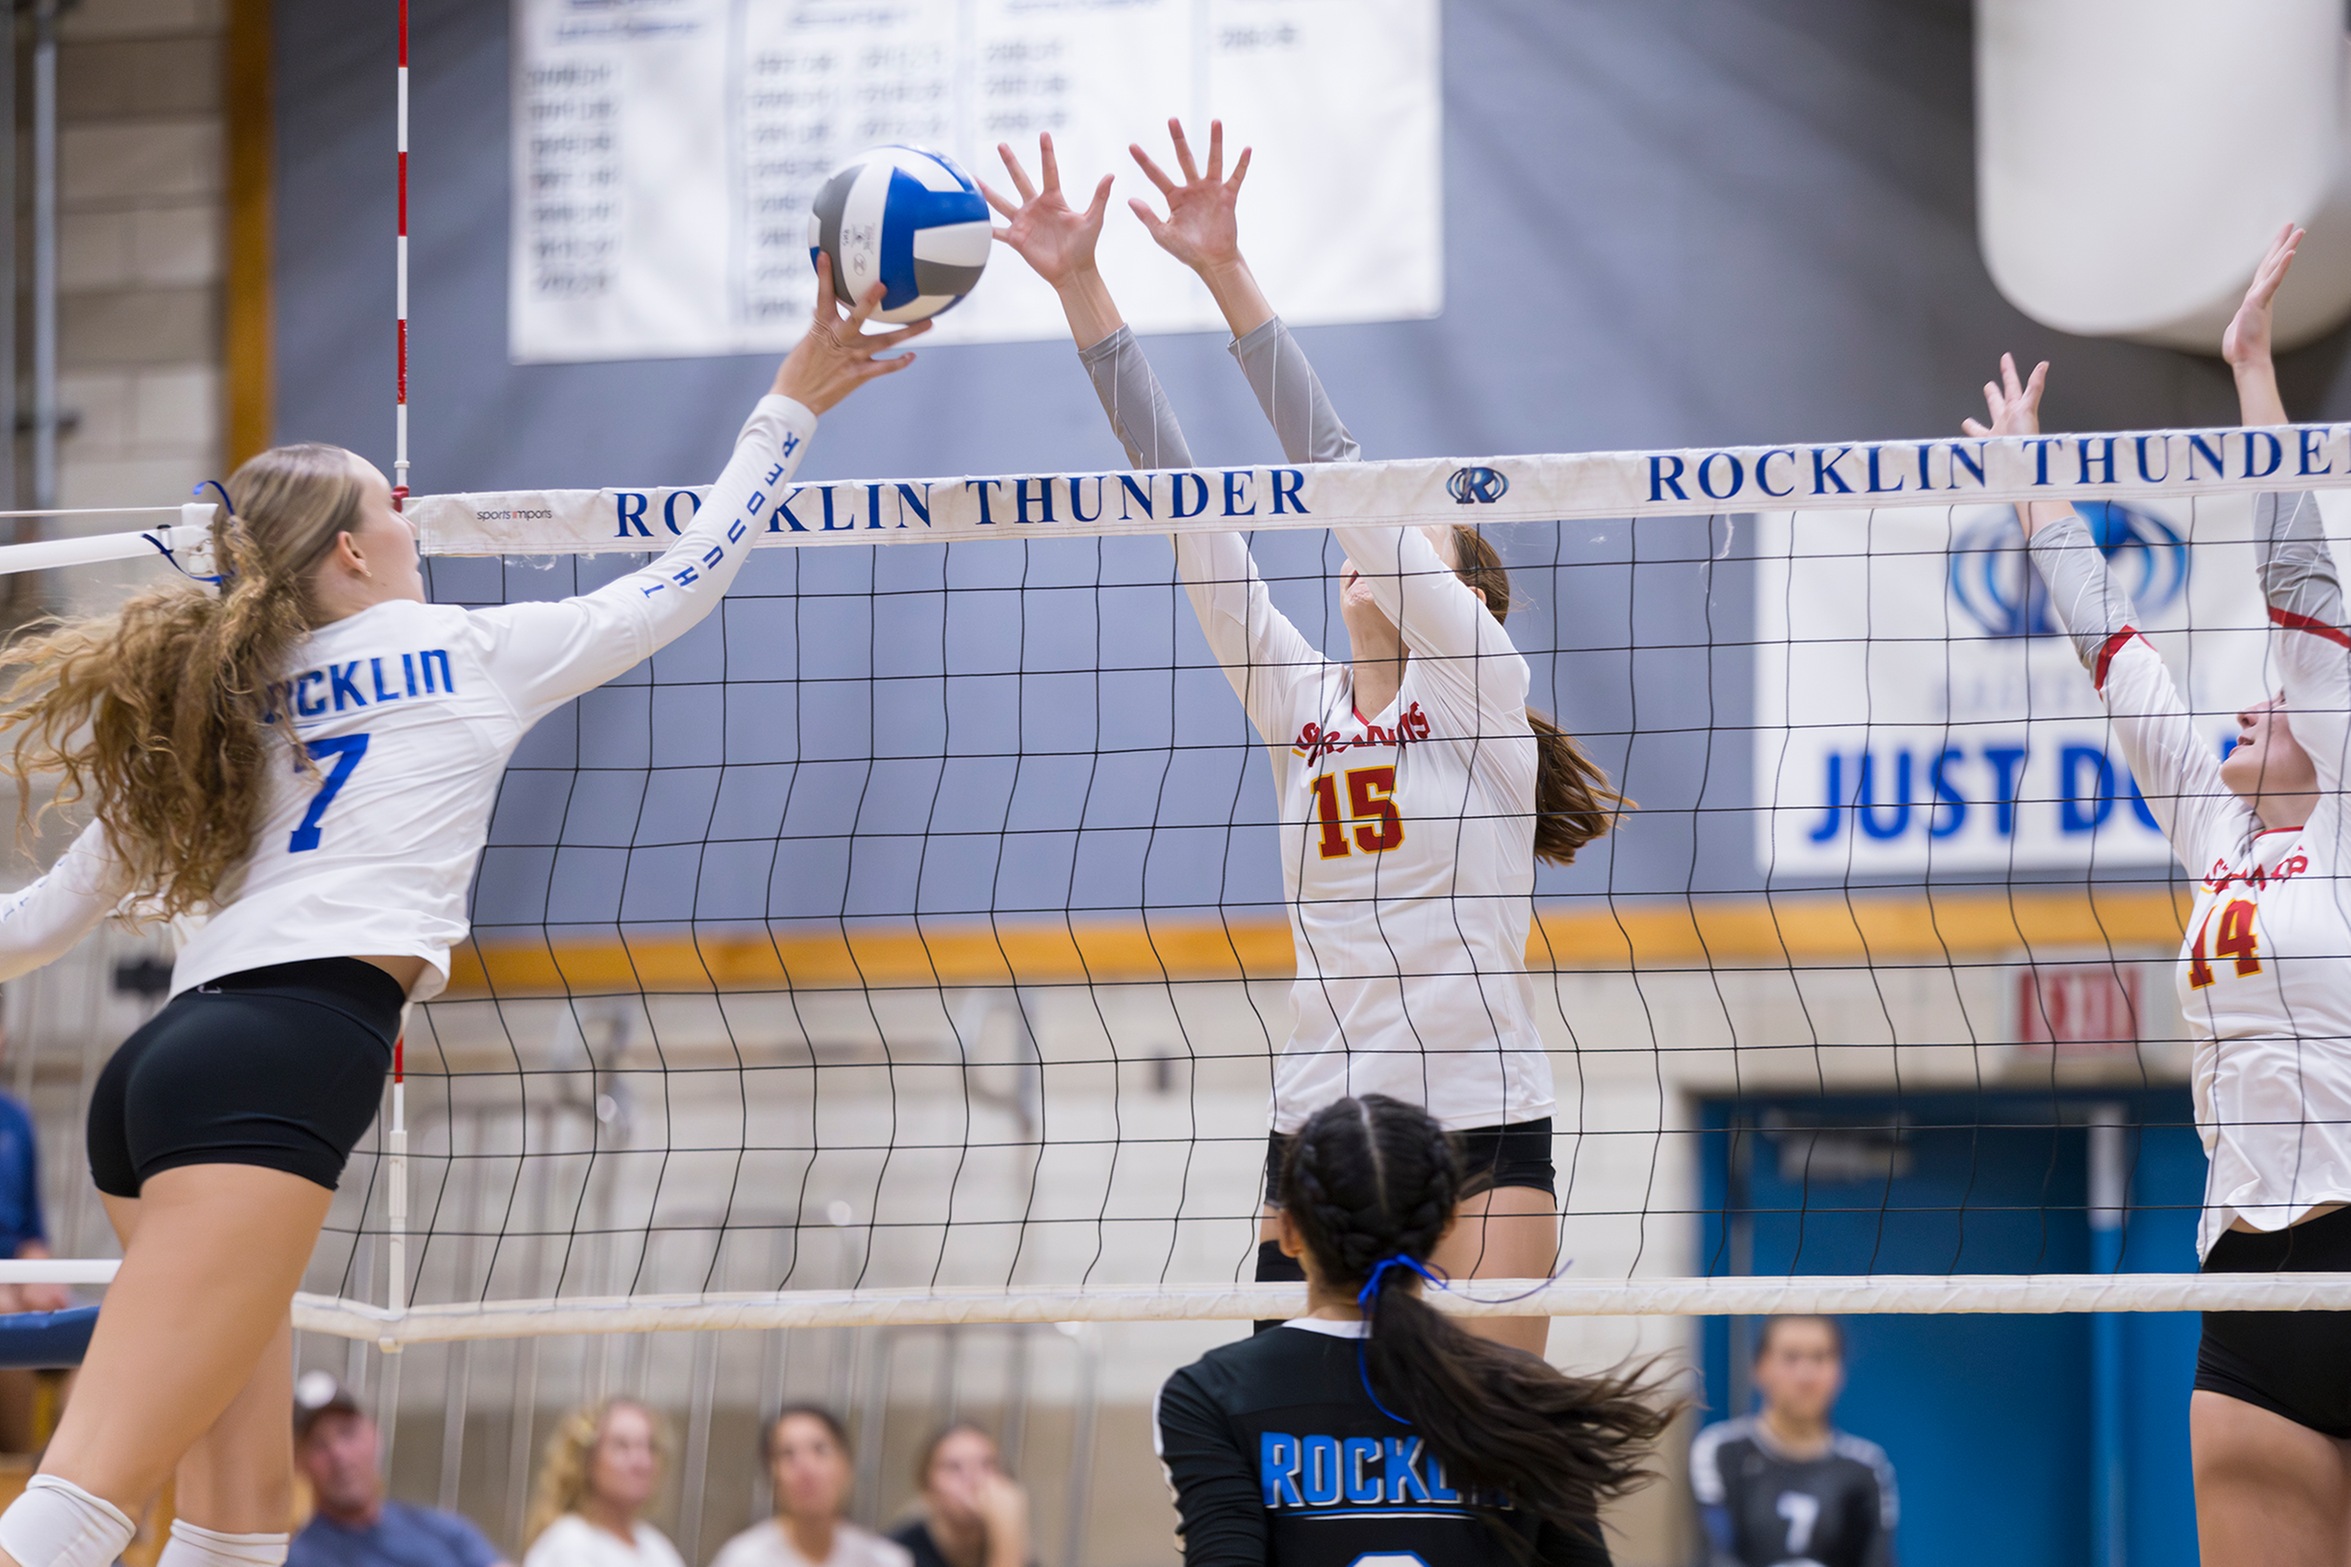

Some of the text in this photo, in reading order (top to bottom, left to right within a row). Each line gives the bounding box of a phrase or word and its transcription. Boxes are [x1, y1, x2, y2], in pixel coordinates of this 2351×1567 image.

[614, 468, 1310, 537] ROKLIN THUNDER
[1647, 427, 2351, 501] ROCKLIN THUNDE
[640, 432, 799, 598] THUNDER
[265, 649, 454, 723] CKLIN
[289, 733, 370, 853] 7
[1310, 765, 1405, 860] 15
[1807, 741, 2024, 843] JUST
[2188, 898, 2263, 991] 14
[1260, 1431, 1514, 1510] ROCKL
